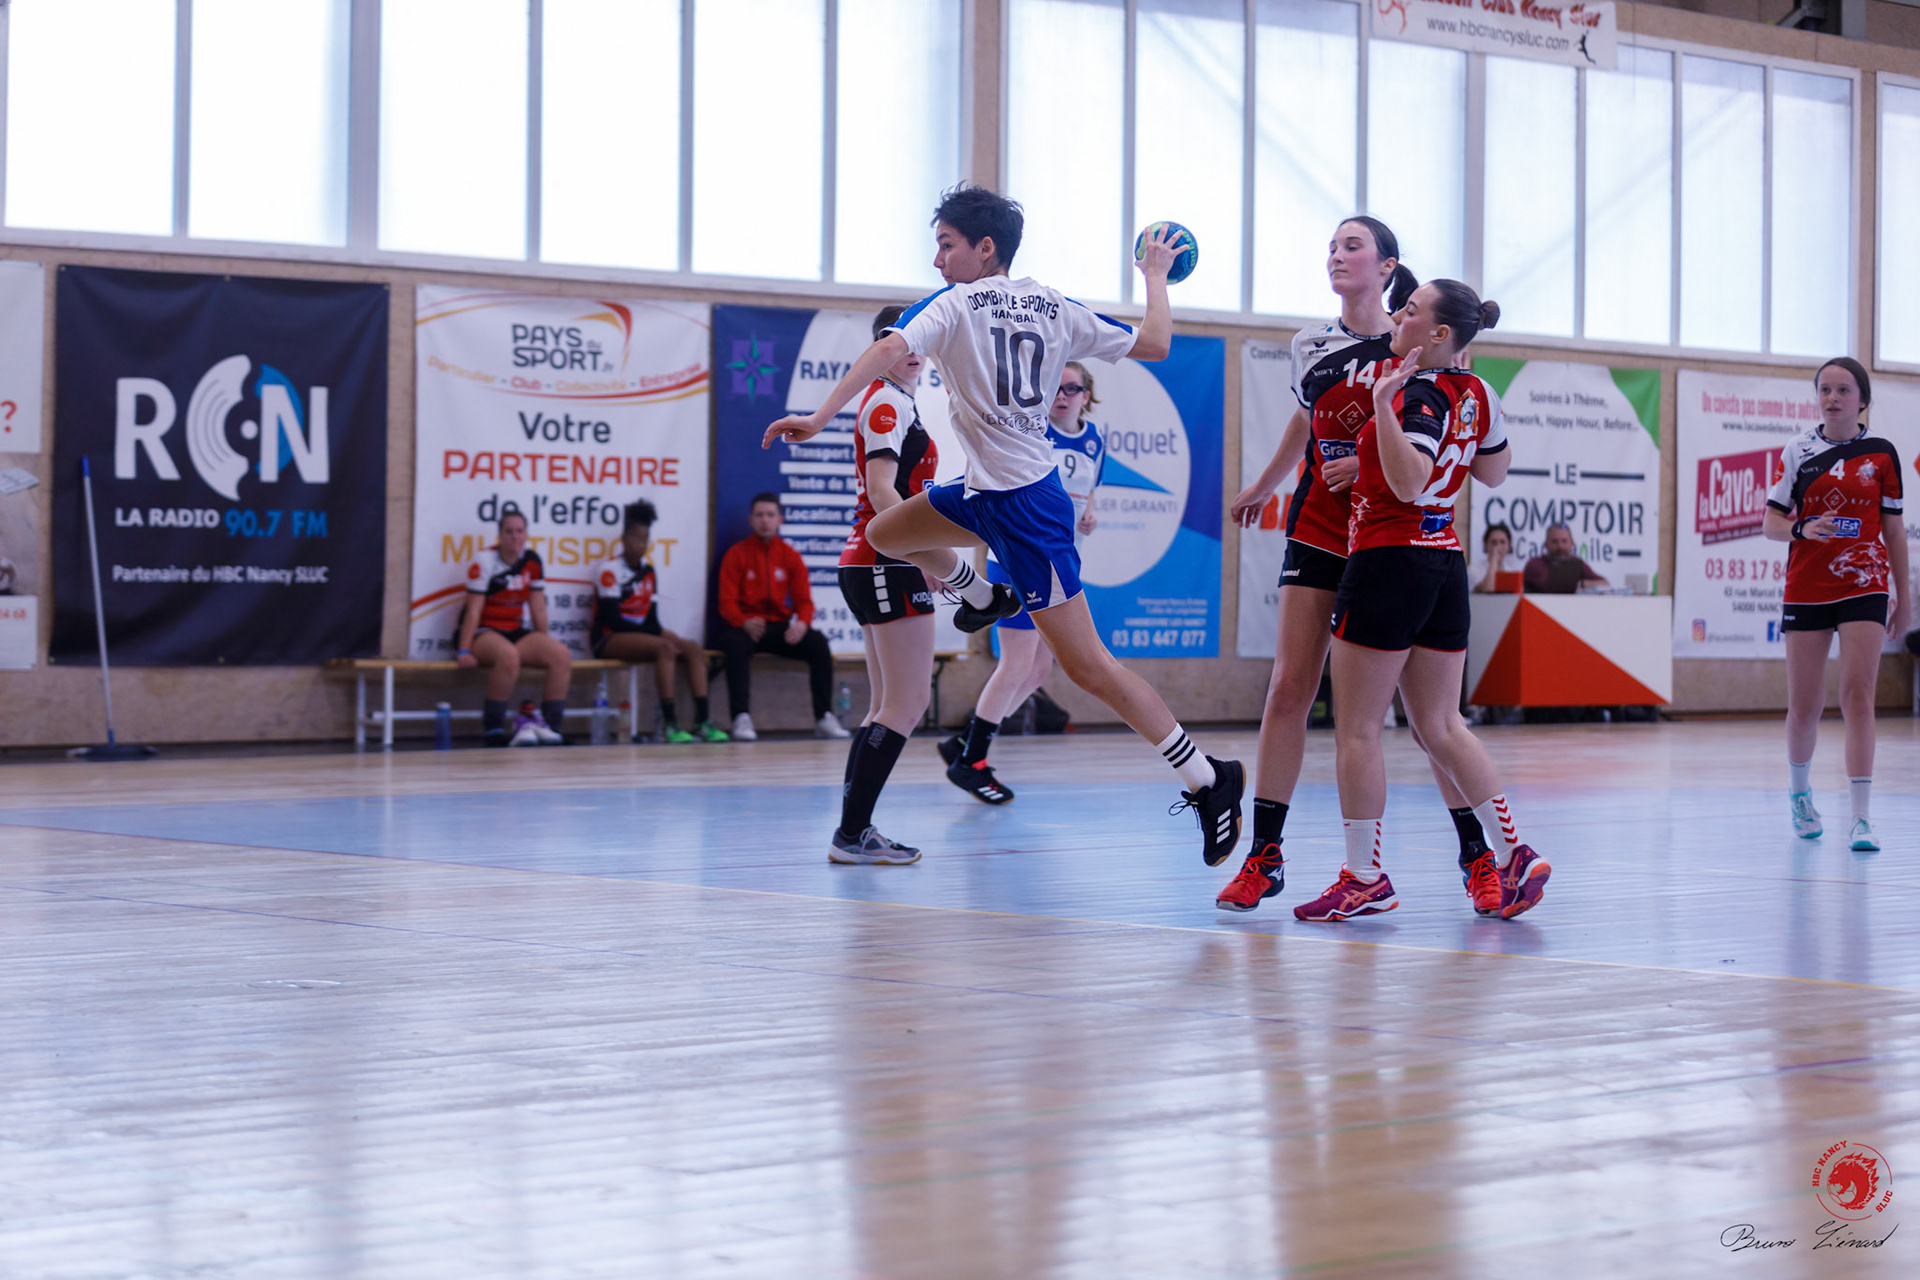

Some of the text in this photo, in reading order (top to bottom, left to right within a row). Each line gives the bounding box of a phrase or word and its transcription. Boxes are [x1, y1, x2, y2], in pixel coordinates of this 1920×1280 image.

[512, 323, 583, 349] PAYS
[427, 355, 497, 385] Particulier
[510, 376, 542, 391] Club
[639, 362, 703, 389] Entreprise
[990, 326, 1045, 408] 10
[1342, 358, 1377, 390] 14
[1742, 398, 1755, 417] pas
[1758, 399, 1783, 418] comme
[519, 411, 612, 443] Votre
[1546, 414, 1574, 430] Happy
[443, 450, 680, 487] PARTENAIRE
[1064, 453, 1077, 478] 9
[1554, 462, 1578, 486] LE
[1828, 458, 1846, 480] 4
[1699, 492, 1709, 520] la
[1709, 459, 1755, 518] Cave
[115, 508, 328, 538] LA RADIO 90.7 FM
[1484, 498, 1644, 535] COMPTOIR
[112, 564, 329, 587] Partenaire du HBC Nancy SLUC
[1705, 558, 1724, 580] 03
[1727, 559, 1745, 580] 83
[1750, 560, 1768, 581] 17
[1112, 629, 1130, 647] 03
[1132, 629, 1150, 647] 83
[1152, 630, 1179, 648] 447
